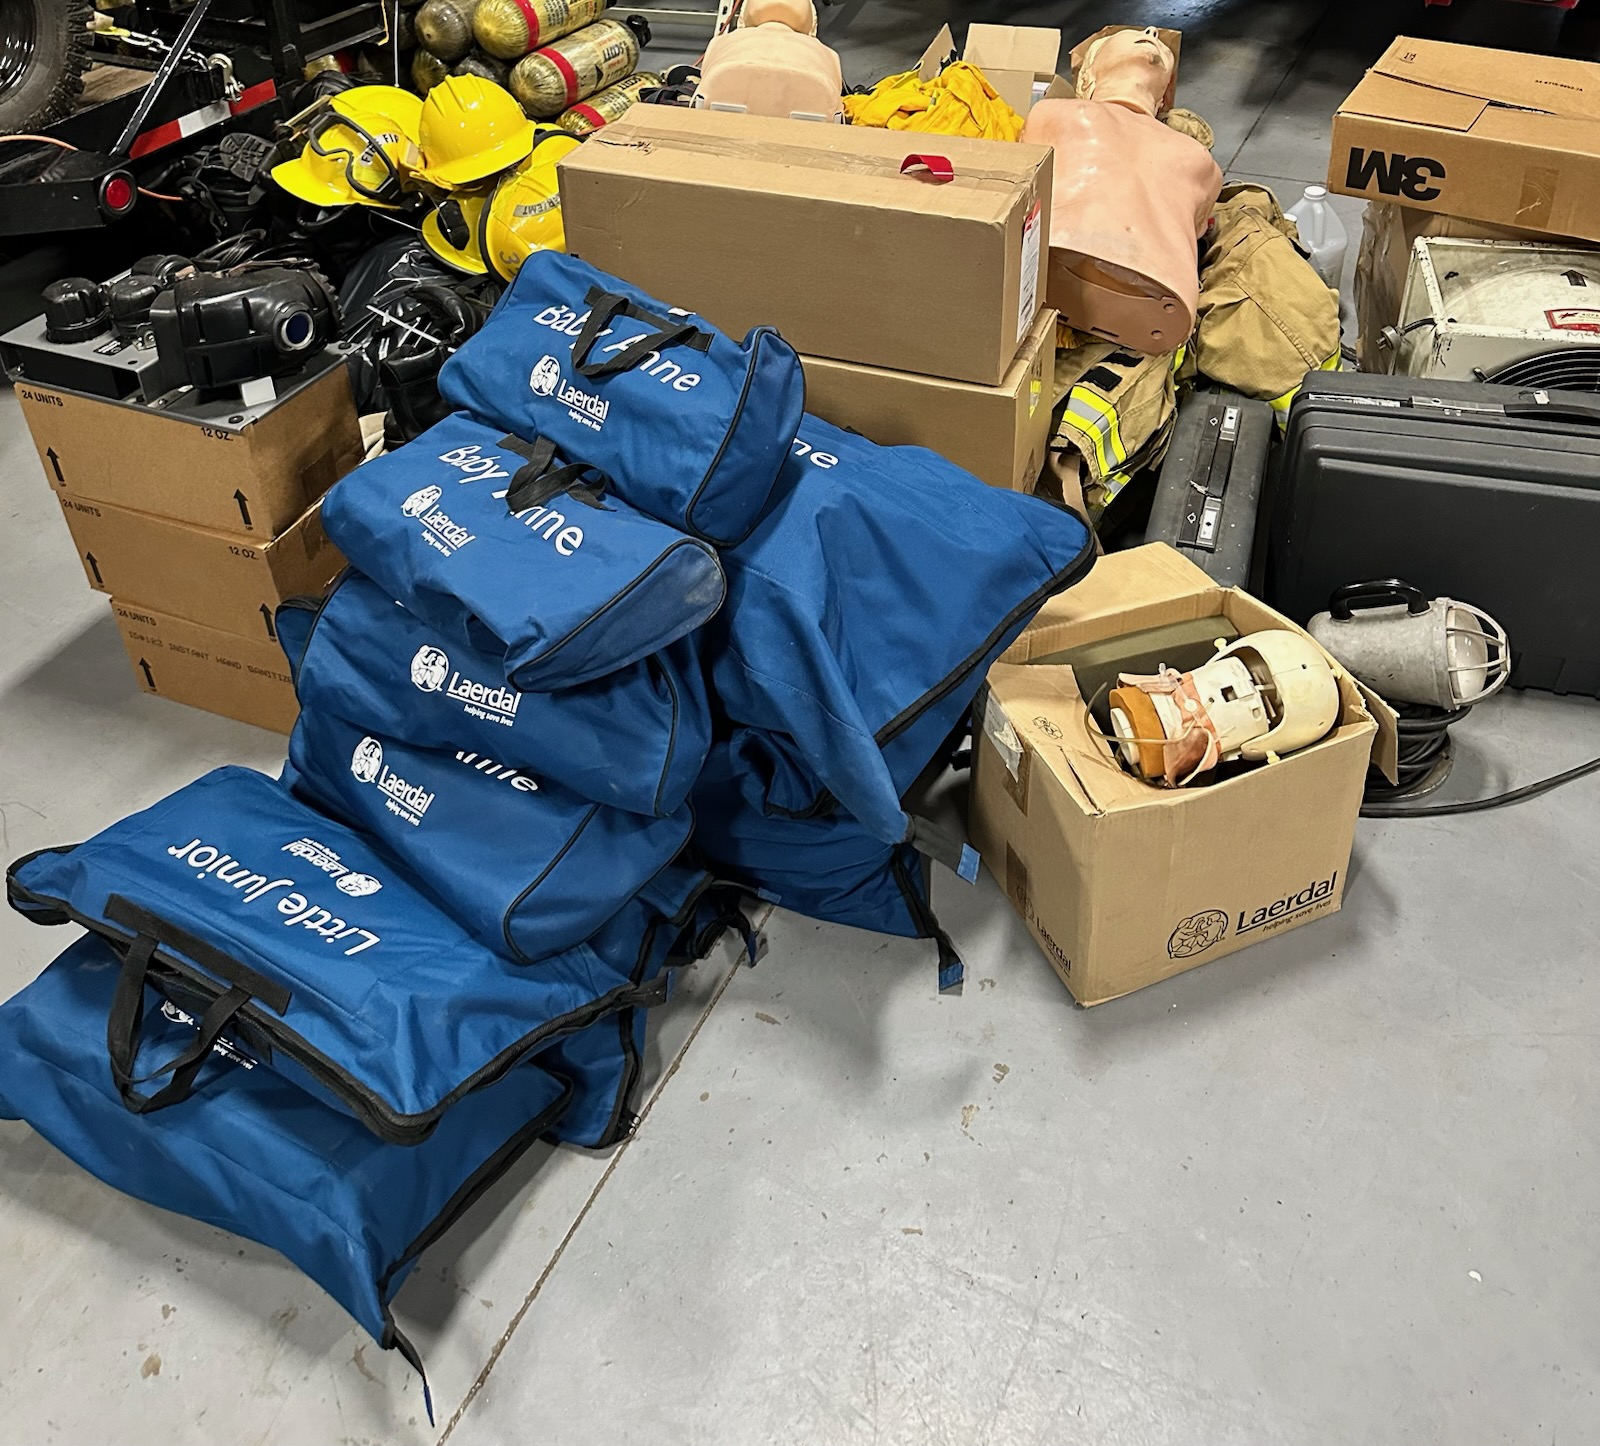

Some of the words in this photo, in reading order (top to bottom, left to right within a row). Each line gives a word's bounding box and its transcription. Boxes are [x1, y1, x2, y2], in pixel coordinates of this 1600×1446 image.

[1345, 147, 1446, 201] 3M
[22, 389, 34, 400] 24
[34, 391, 64, 407] UNITS
[557, 378, 610, 419] Laerdal
[201, 427, 213, 438] 12
[793, 437, 839, 469] ne
[62, 498, 73, 509] 24
[74, 502, 102, 518] UNITS
[438, 445, 510, 485] Baby
[492, 488, 585, 557] nne
[422, 503, 477, 549] Laerdal
[228, 546, 240, 556] 12
[117, 608, 129, 618] 24
[129, 611, 157, 626] UNITS
[447, 671, 523, 714] Laerdal
[379, 765, 436, 814] Laerdal
[167, 838, 295, 904] Junior
[280, 840, 350, 879] Laerdal
[1236, 869, 1338, 932] Laerdal
[277, 892, 381, 956] Little
[1036, 916, 1072, 972] Laerdal
